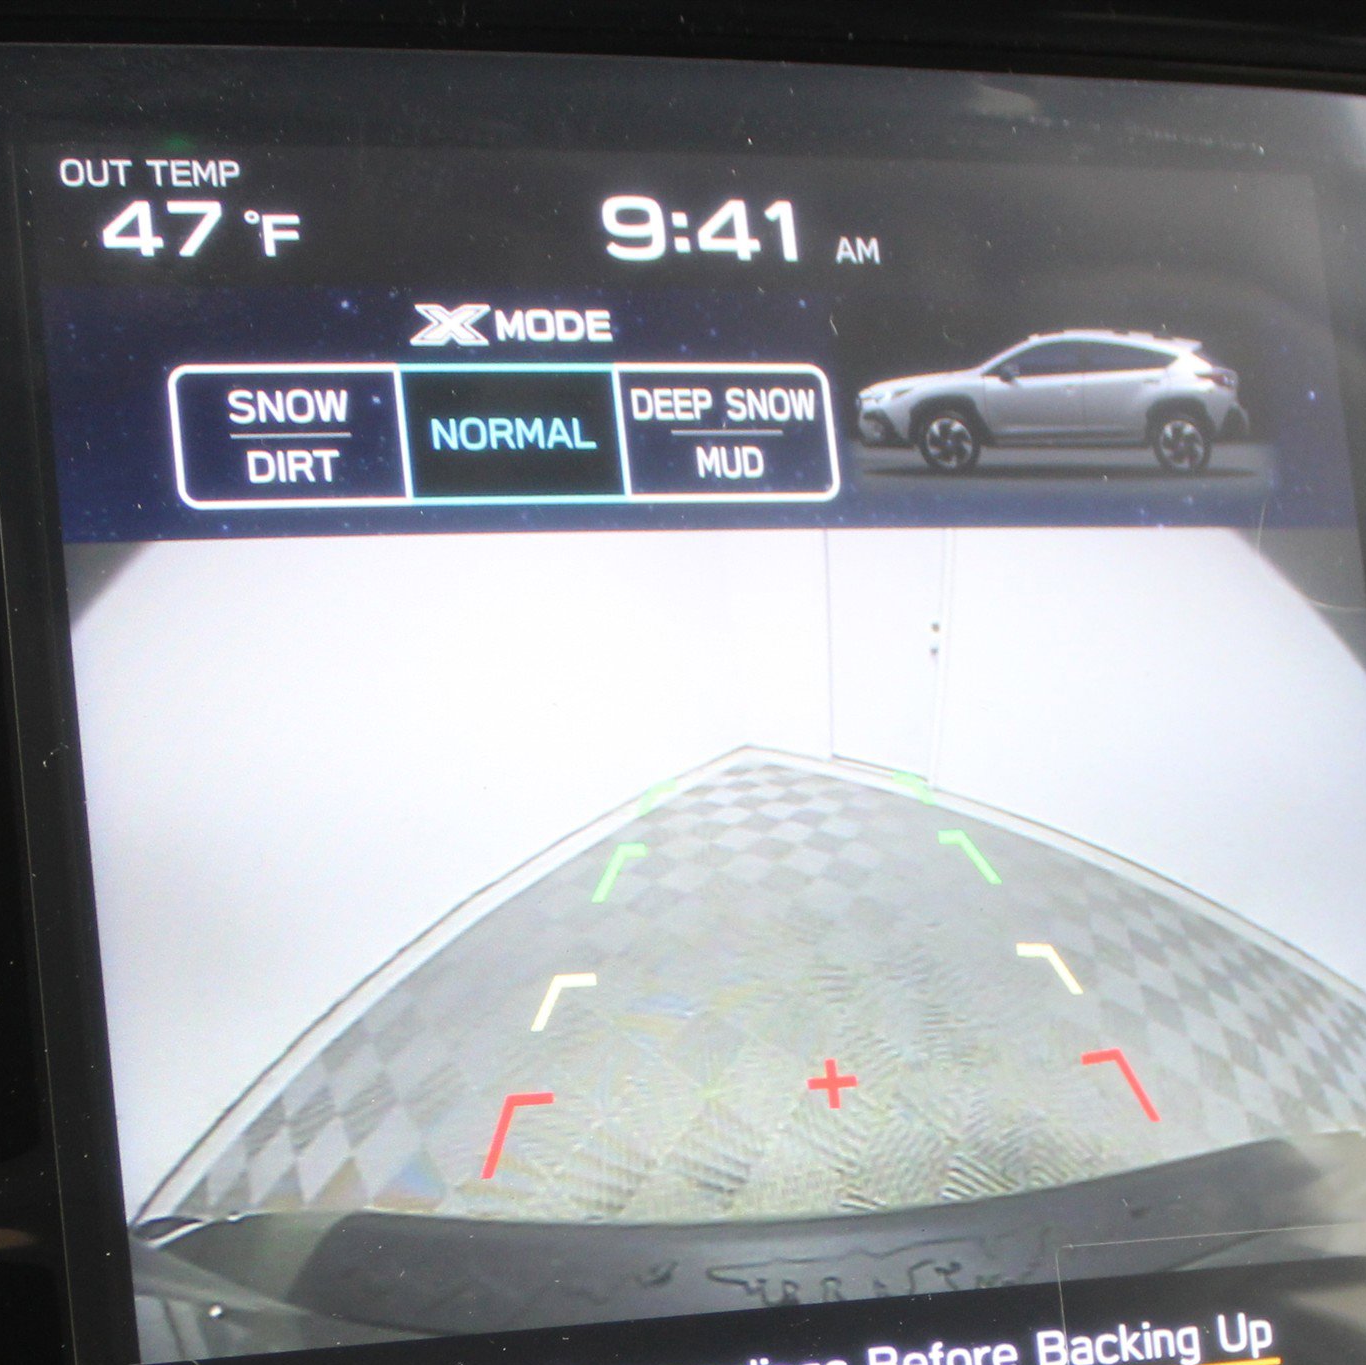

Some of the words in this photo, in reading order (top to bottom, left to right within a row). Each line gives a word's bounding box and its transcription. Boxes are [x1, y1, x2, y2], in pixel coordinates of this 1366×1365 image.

[59, 160, 131, 187] OUT
[146, 159, 240, 187] TEMP
[601, 194, 799, 262] 9:41
[835, 236, 881, 265] AM
[494, 311, 613, 342] MODE
[227, 389, 348, 423] SNOW
[632, 388, 712, 421] DEEP
[726, 388, 815, 421] SNOW
[430, 417, 597, 451] NORMAL
[246, 448, 340, 482] DIRT
[696, 446, 765, 479] MUD
[1215, 1314, 1274, 1356] Up
